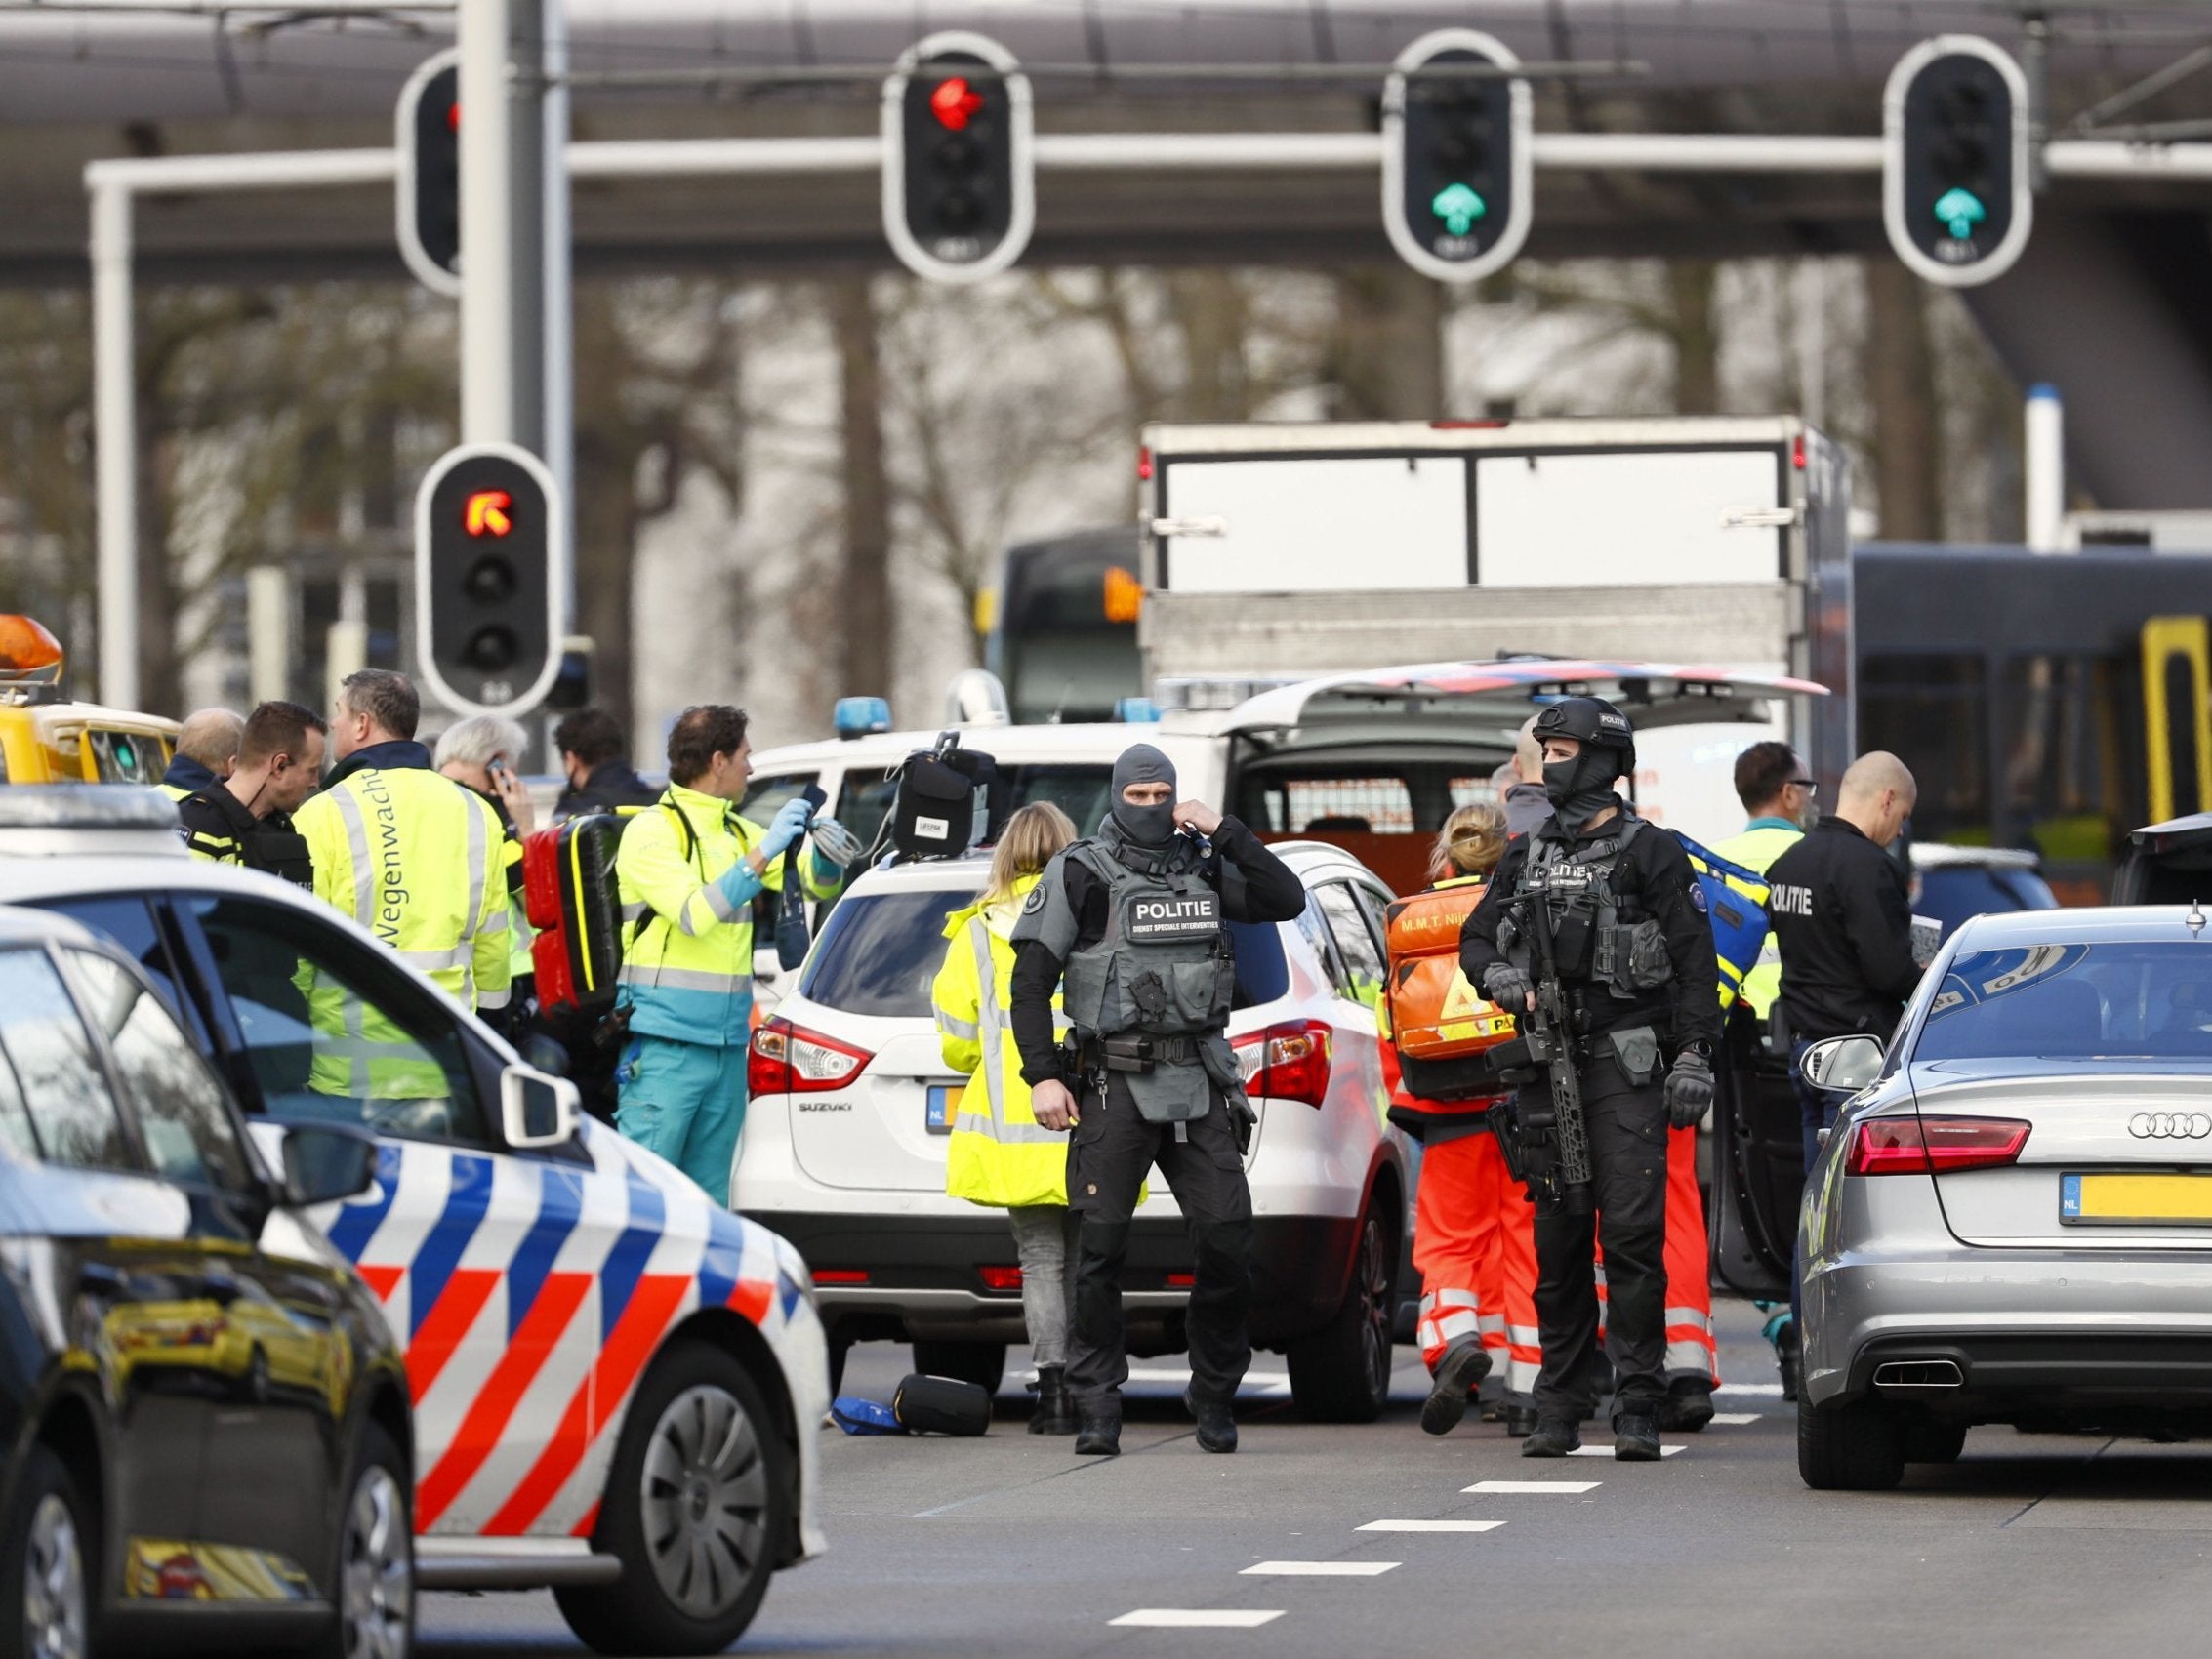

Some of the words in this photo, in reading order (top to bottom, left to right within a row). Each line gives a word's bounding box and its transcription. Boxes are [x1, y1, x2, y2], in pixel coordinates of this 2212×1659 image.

[362, 768, 410, 949] Wegenwacht
[1136, 900, 1212, 920] POLITIE
[1132, 924, 1153, 934] DIENST
[1154, 922, 1180, 932] SPECIALE
[1181, 920, 1219, 931] INTERVENTIES
[1401, 915, 1442, 932] M.M.T.
[799, 1102, 853, 1113] SUZUKI
[929, 1110, 943, 1120] NL
[2064, 1199, 2078, 1210] NL
